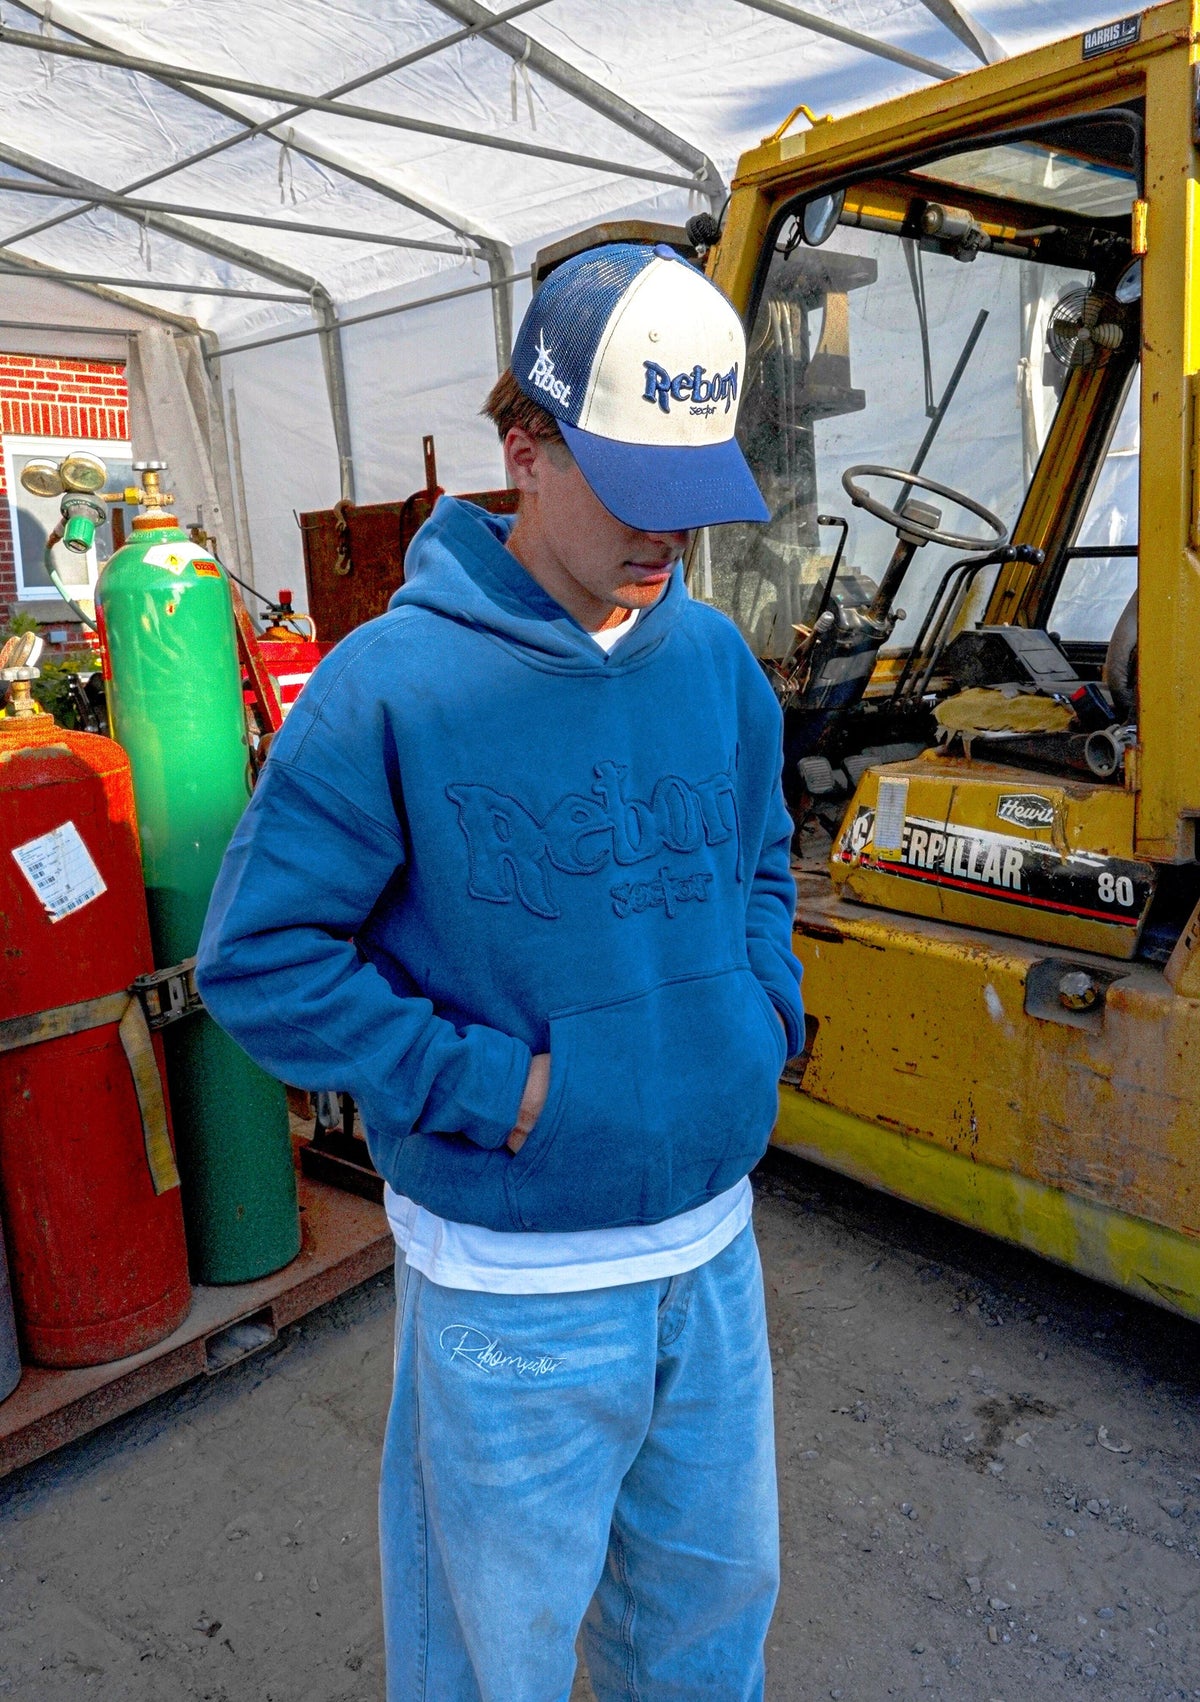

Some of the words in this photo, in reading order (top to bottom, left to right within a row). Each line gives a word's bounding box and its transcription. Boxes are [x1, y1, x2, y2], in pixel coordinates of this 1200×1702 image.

[1085, 24, 1120, 49] HARRIS
[1000, 799, 1054, 823] Hewit
[851, 815, 1024, 891] CERPILLAR
[1098, 872, 1134, 907] 80
